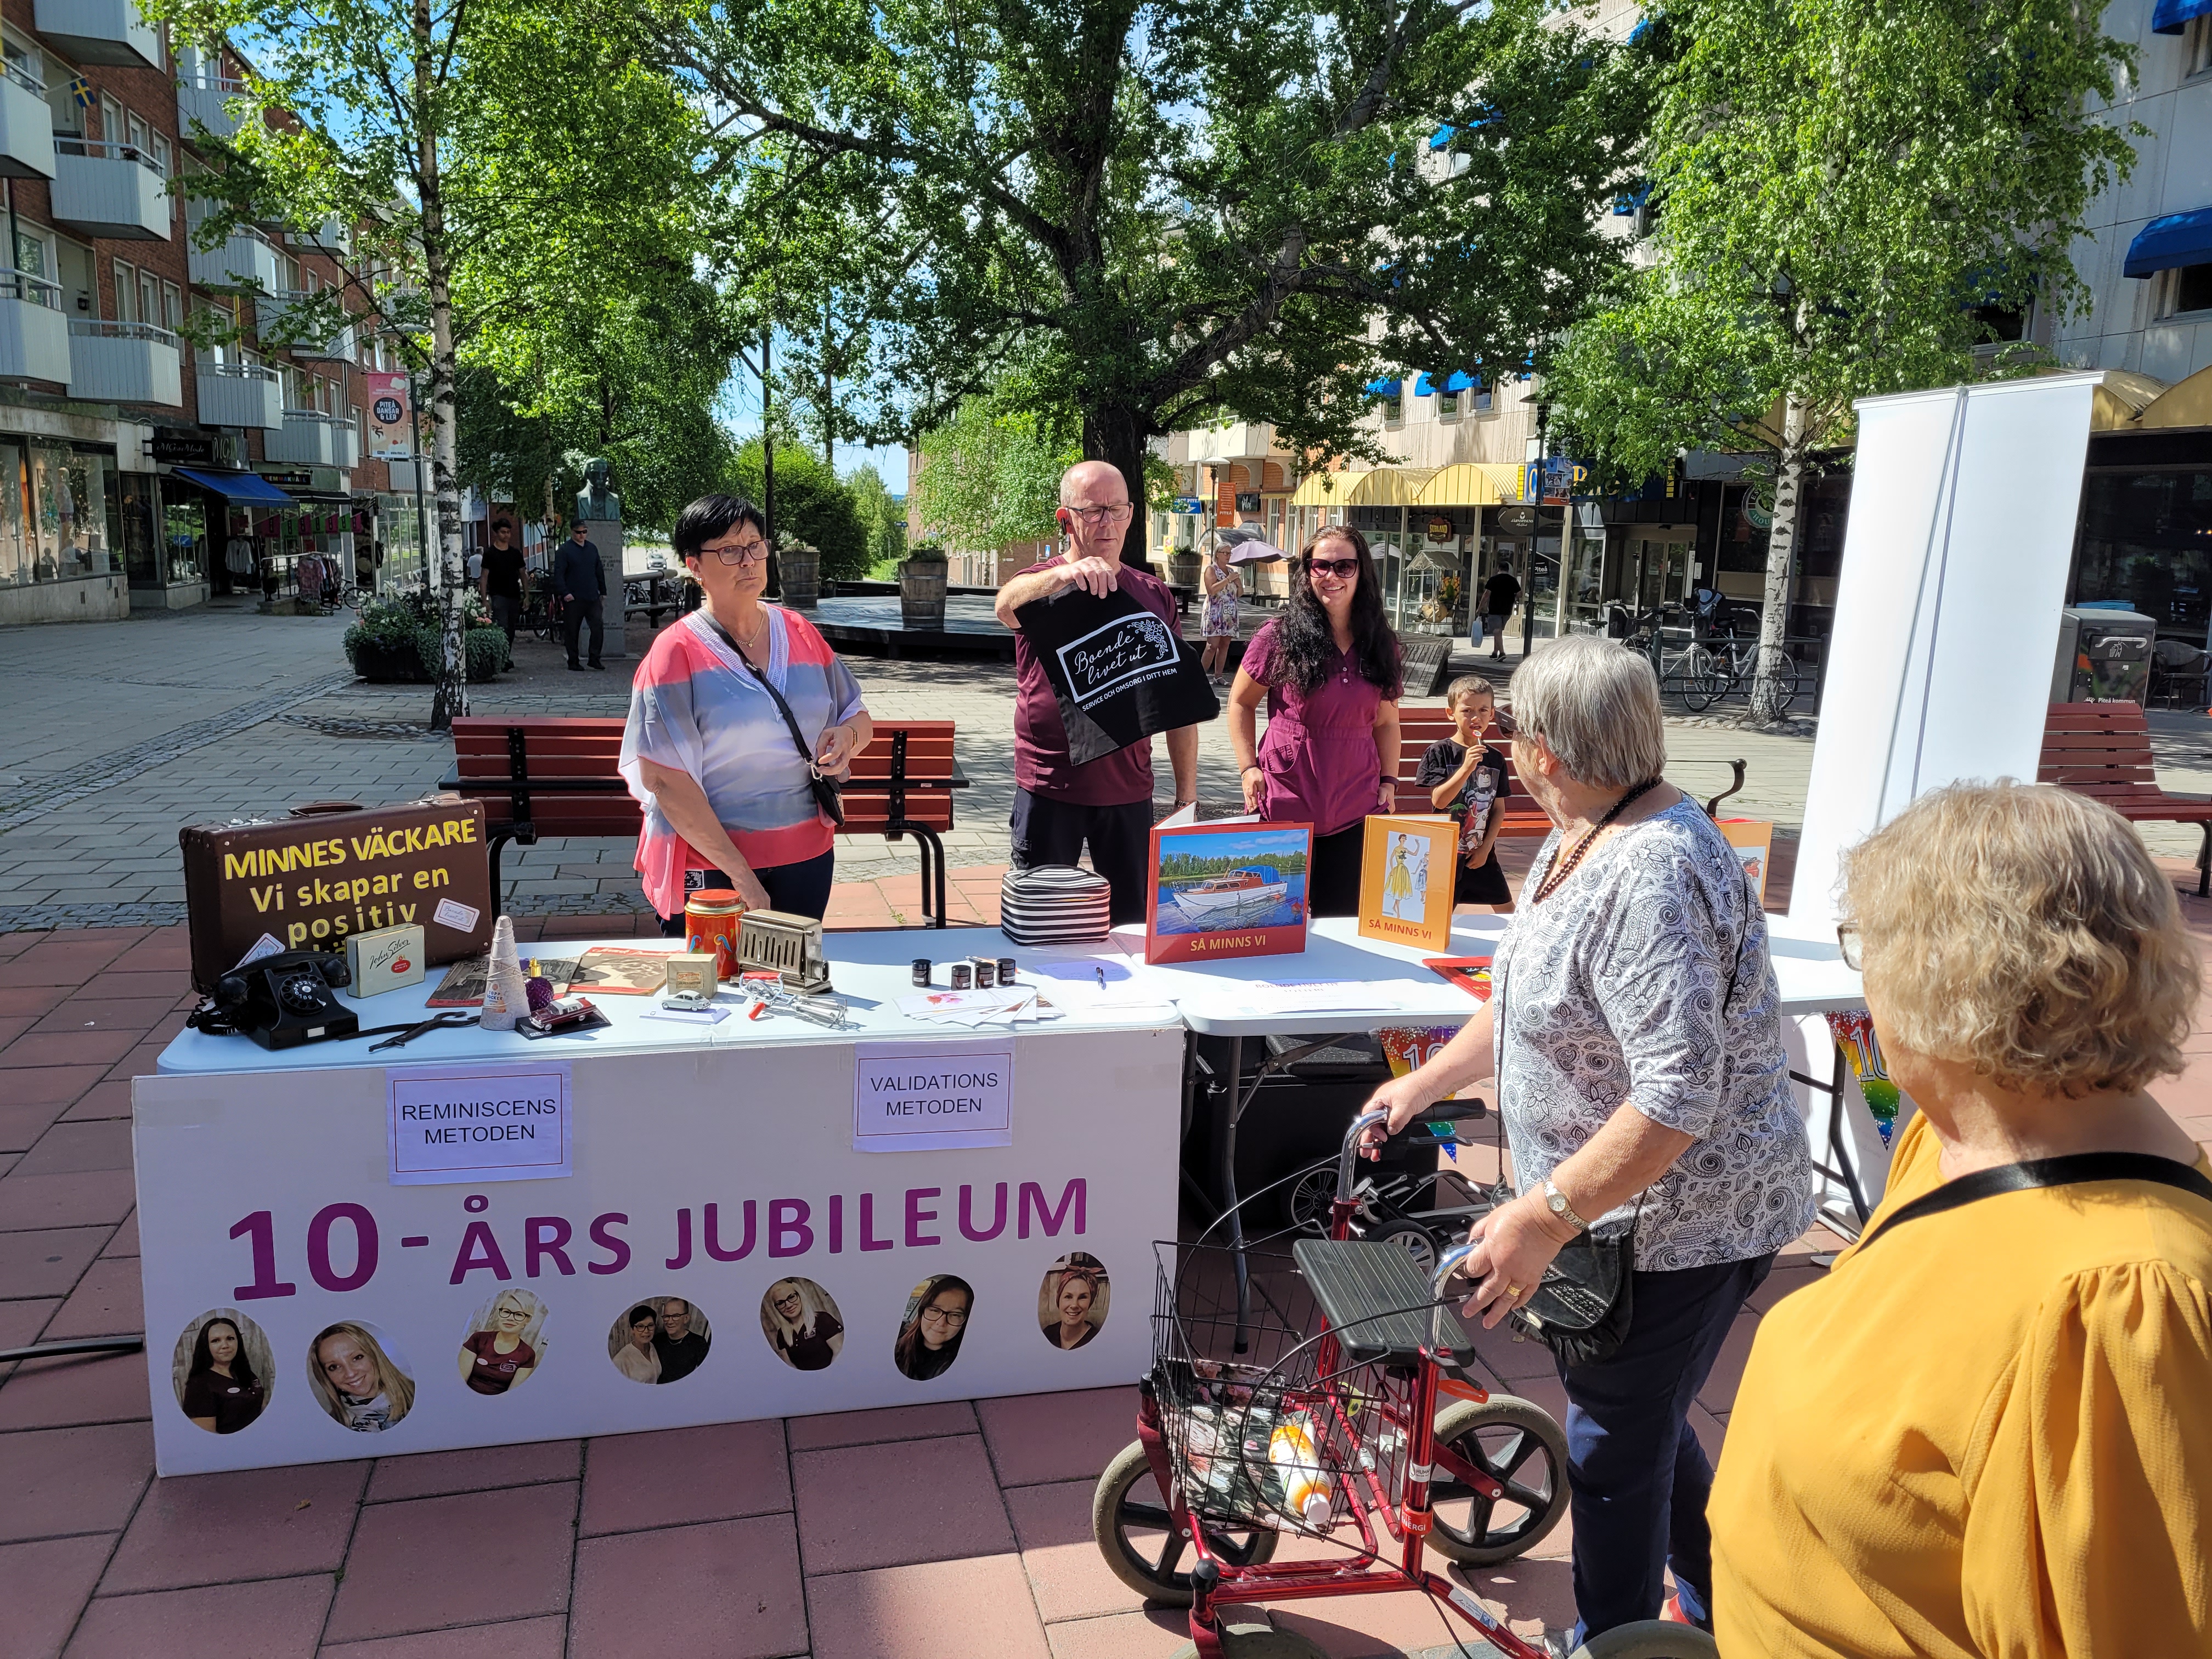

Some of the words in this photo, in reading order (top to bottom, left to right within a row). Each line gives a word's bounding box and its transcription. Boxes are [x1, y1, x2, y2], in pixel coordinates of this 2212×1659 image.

[379, 399, 396, 408] PITEÅ
[1429, 523, 1448, 534] SUBLAND
[1752, 514, 1774, 525] HOU
[1074, 630, 1136, 675] Boende
[1088, 655, 1128, 685] livet
[1128, 644, 1149, 662] ut
[1082, 696, 1104, 712] SERVICE
[1103, 689, 1116, 700] OCH
[1115, 676, 1143, 693] OMSORG
[1146, 672, 1161, 680] DITT
[1162, 667, 1177, 676] HEM
[224, 838, 347, 881] MINNES
[351, 817, 477, 862] VÄCKARE
[249, 882, 285, 913] Vi
[297, 871, 403, 907] skapar
[413, 867, 450, 890] en
[287, 901, 417, 950] positiv
[1368, 918, 1381, 930] SÅ
[1384, 922, 1419, 937] MINNS
[1421, 929, 1432, 940] VI
[369, 950, 388, 970] John
[387, 939, 411, 960] Silver
[1190, 938, 1206, 951] SÅ
[1209, 936, 1252, 950] MINNS
[1254, 934, 1266, 946] VI
[870, 1071, 998, 1092] VALIDATIONS
[402, 1098, 557, 1122] REMINISCENS
[885, 1097, 983, 1118] METODEN
[424, 1124, 535, 1146] METODEN
[665, 1177, 1087, 1271] JUBILEUM
